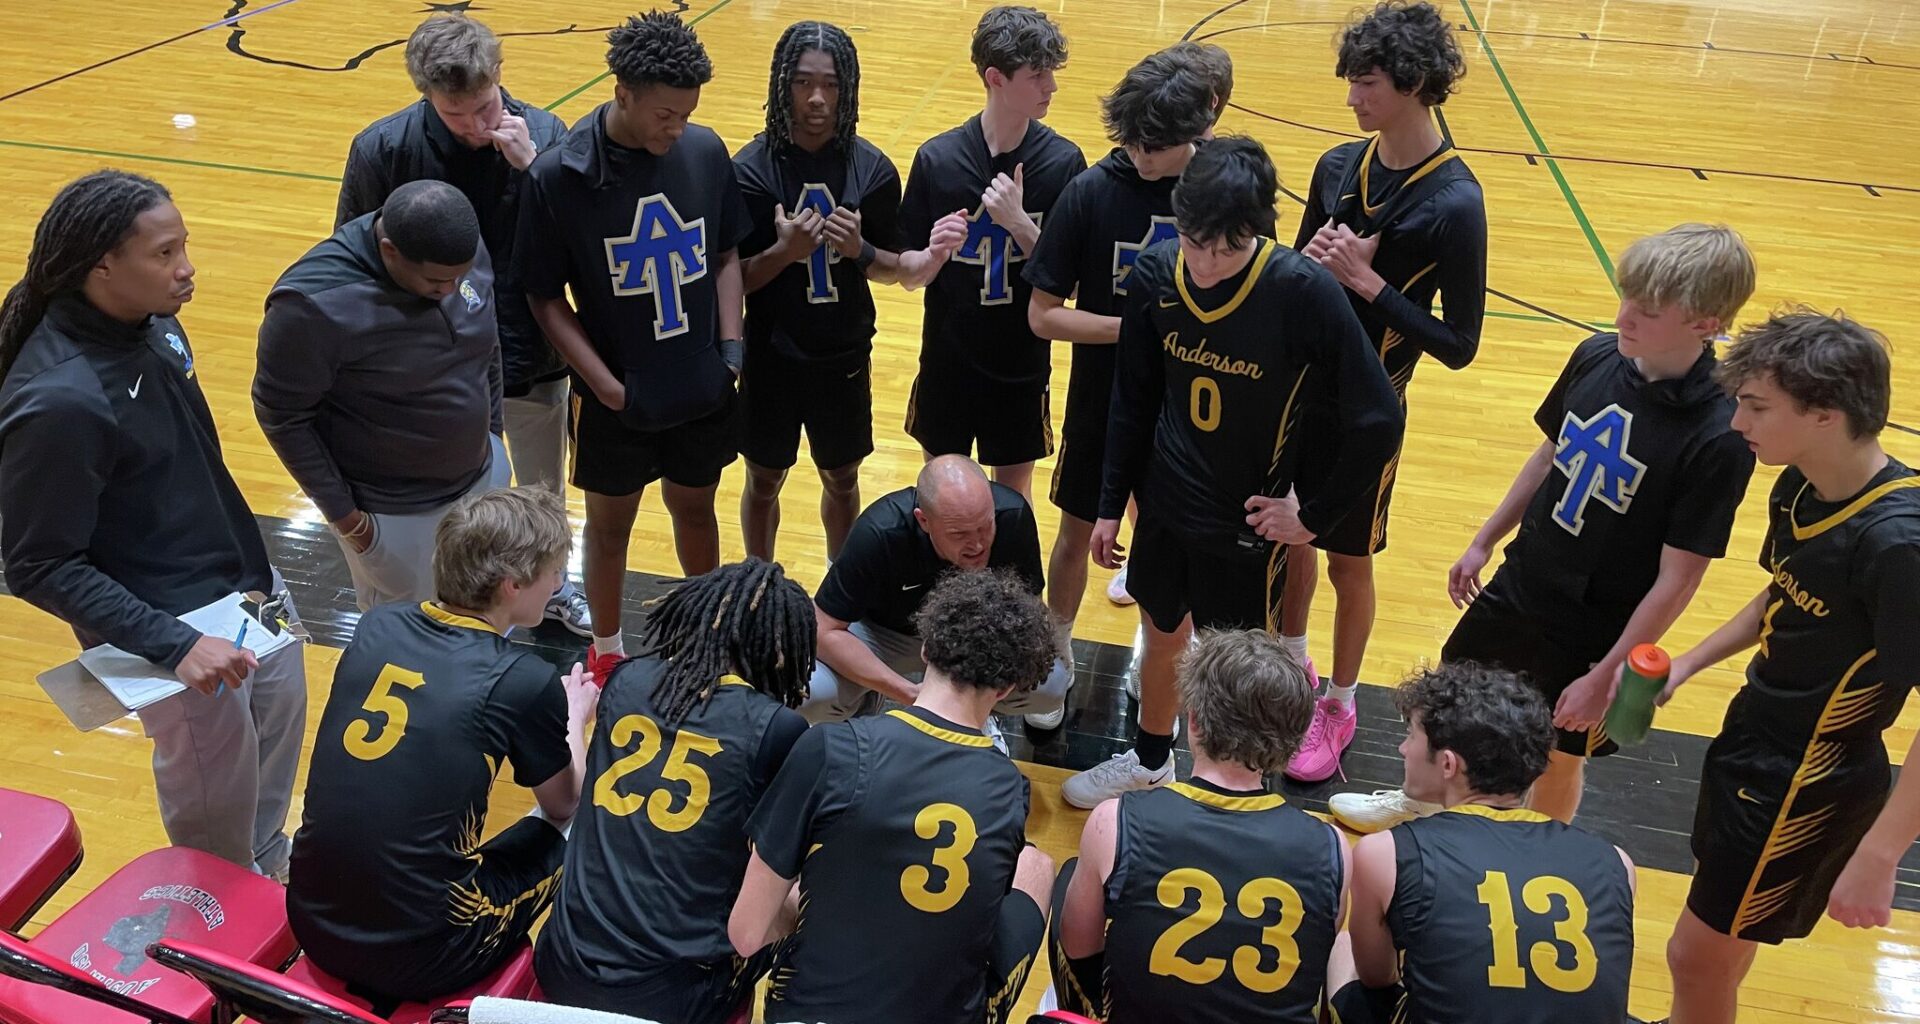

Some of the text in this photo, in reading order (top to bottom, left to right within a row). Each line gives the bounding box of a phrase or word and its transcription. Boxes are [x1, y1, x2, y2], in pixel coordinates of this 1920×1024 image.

[1162, 331, 1264, 380] Anderson
[1190, 376, 1222, 432] 0
[1770, 539, 1831, 618] derson
[343, 661, 426, 761] 5
[592, 713, 721, 832] 25
[139, 884, 225, 931] ATHLETICS
[899, 802, 979, 914] 3
[1149, 867, 1306, 993] 23
[1476, 869, 1599, 993] 13
